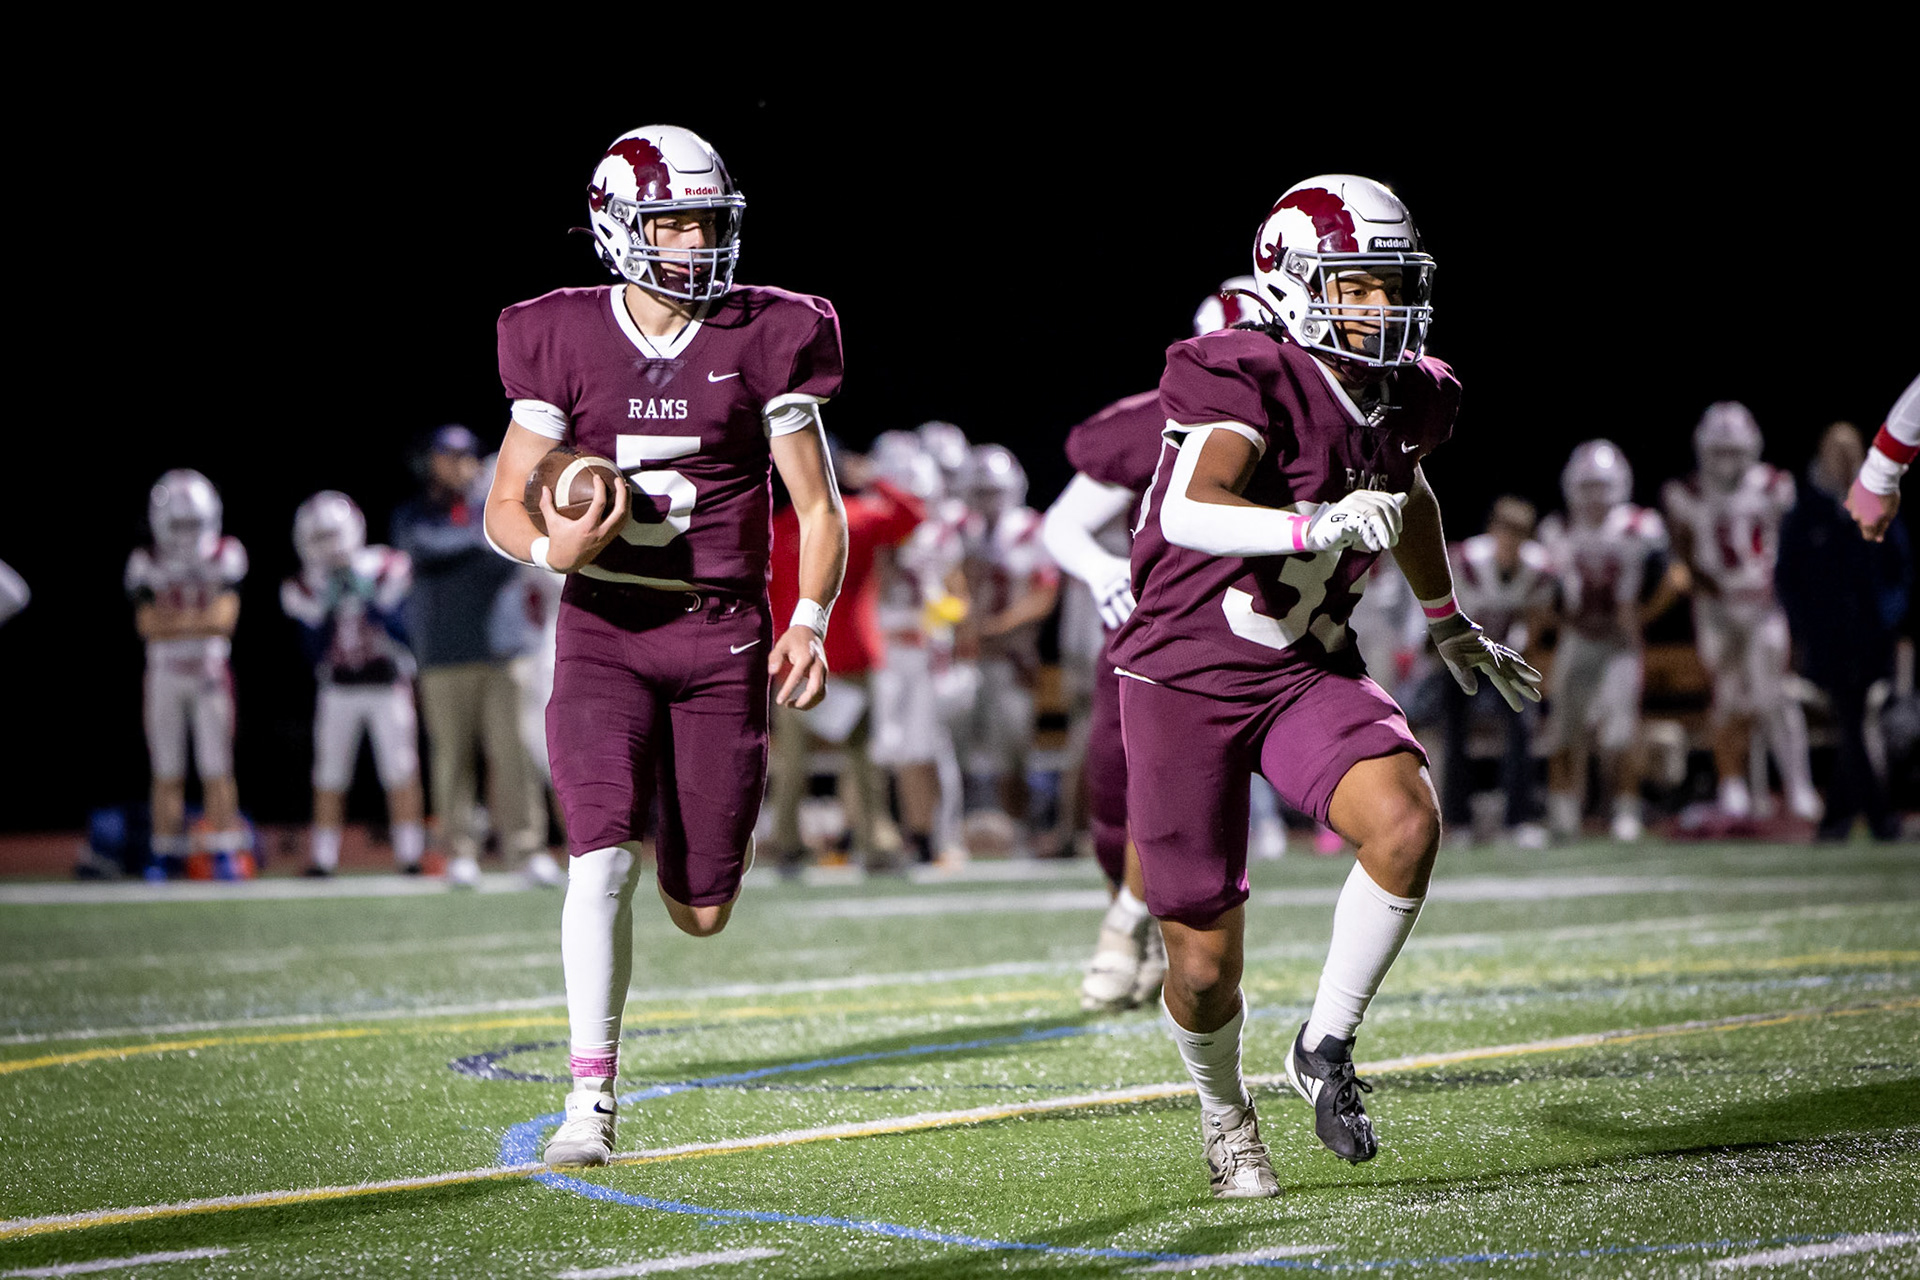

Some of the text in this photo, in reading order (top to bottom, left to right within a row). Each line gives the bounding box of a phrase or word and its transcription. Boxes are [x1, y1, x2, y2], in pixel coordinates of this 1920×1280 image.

[684, 186, 719, 196] Riddell
[1374, 238, 1410, 248] Riddell
[628, 398, 688, 419] RAMS
[1344, 467, 1389, 492] RAMS
[616, 434, 701, 547] 5
